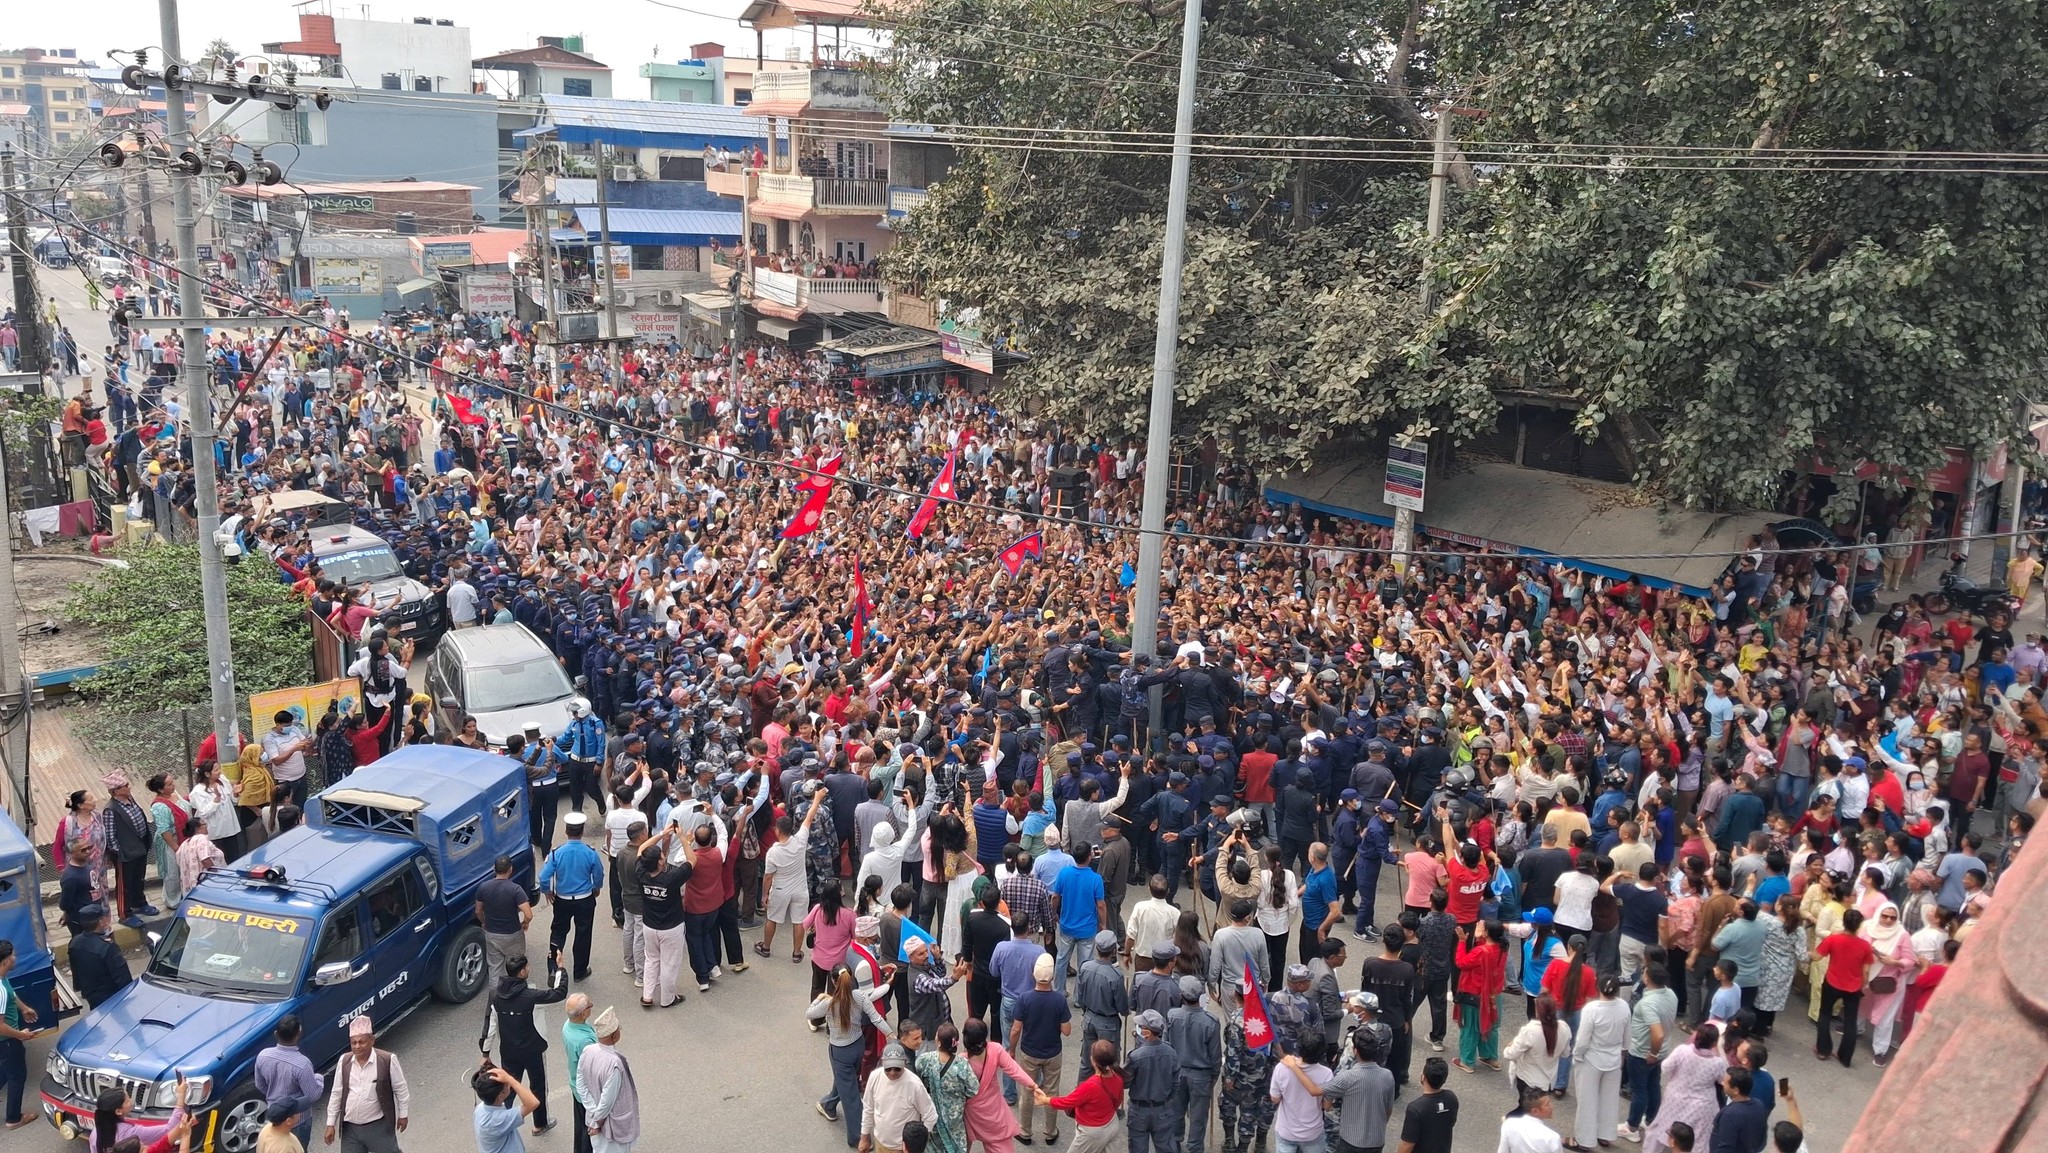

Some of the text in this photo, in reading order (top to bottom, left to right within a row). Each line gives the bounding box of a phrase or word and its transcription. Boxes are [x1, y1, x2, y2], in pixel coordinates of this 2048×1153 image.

[656, 324, 675, 332] पसल
[318, 548, 390, 566] NEPAL POLICE
[187, 904, 299, 934] नेपाल प्रहरी
[338, 971, 409, 1028] नेपाल प्रहरी
